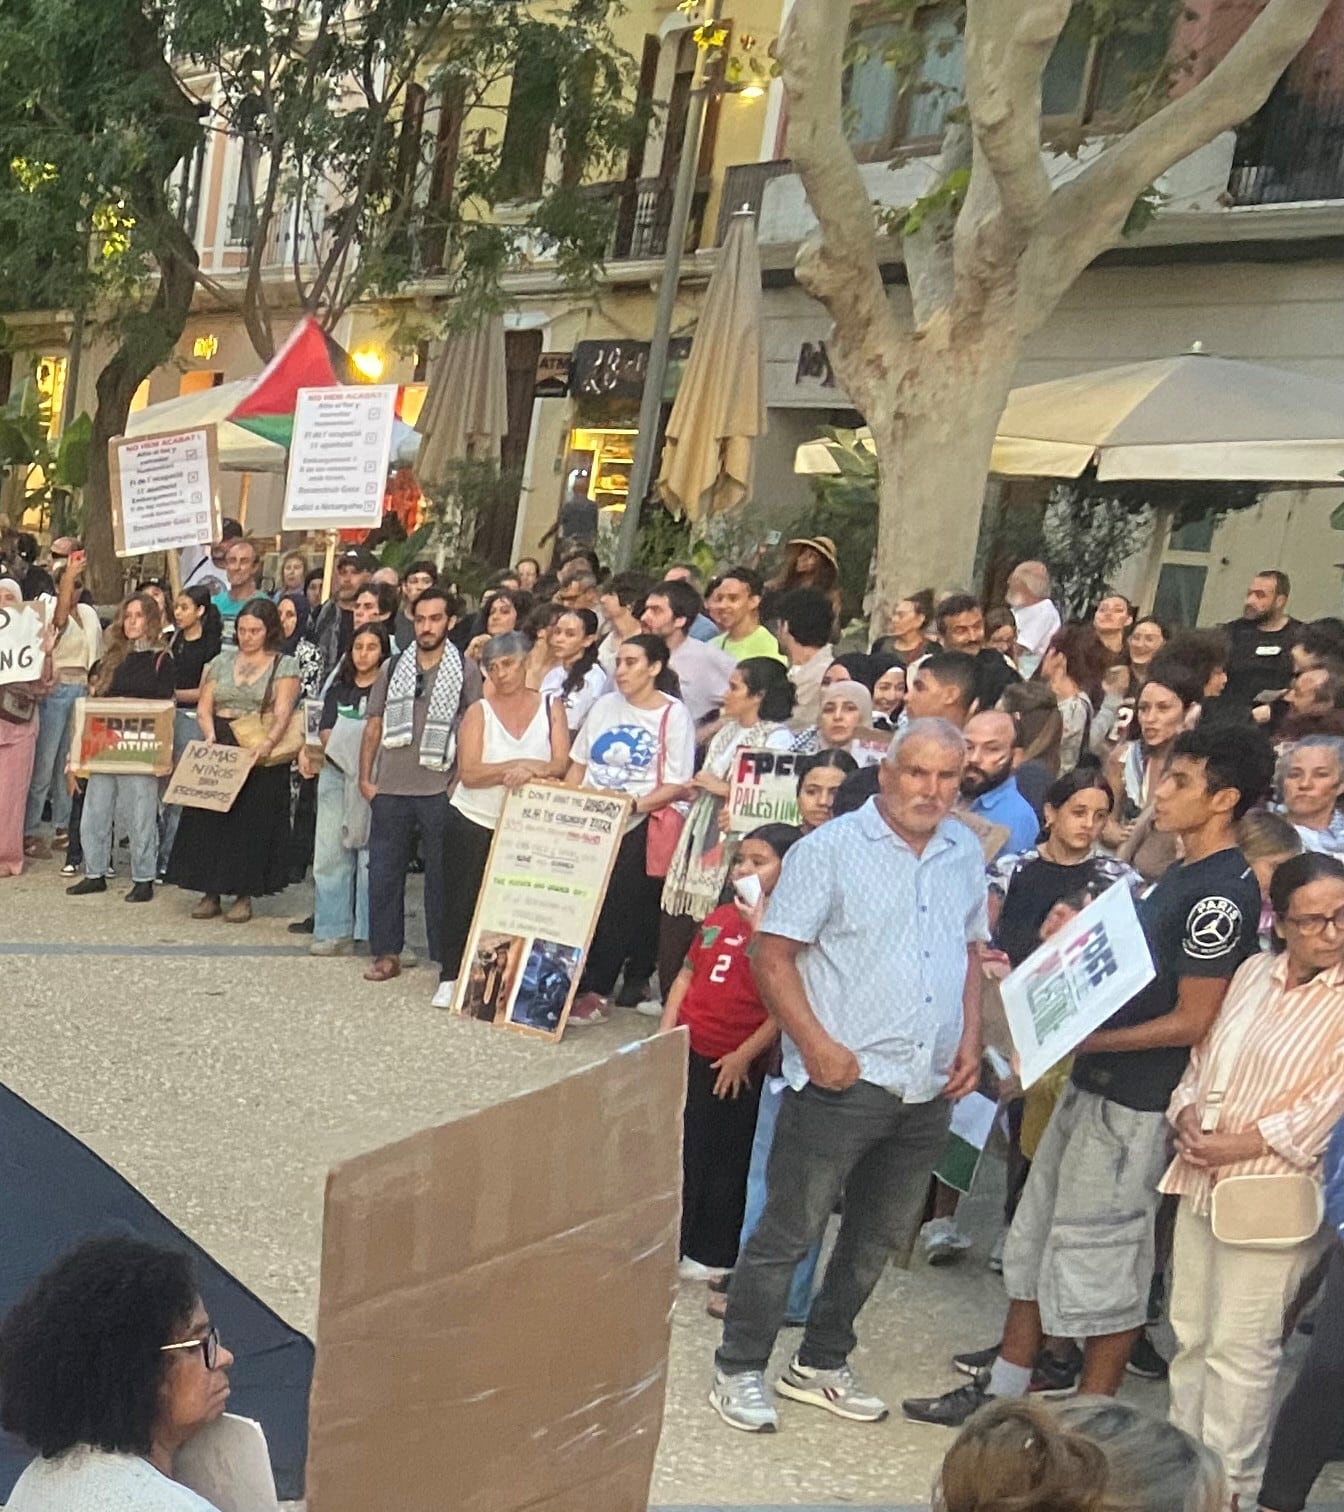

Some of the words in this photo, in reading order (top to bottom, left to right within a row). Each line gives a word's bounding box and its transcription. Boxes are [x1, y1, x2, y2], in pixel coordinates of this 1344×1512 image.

[737, 752, 802, 784] FRE
[1197, 899, 1238, 920] PARIS
[710, 954, 732, 983] 2
